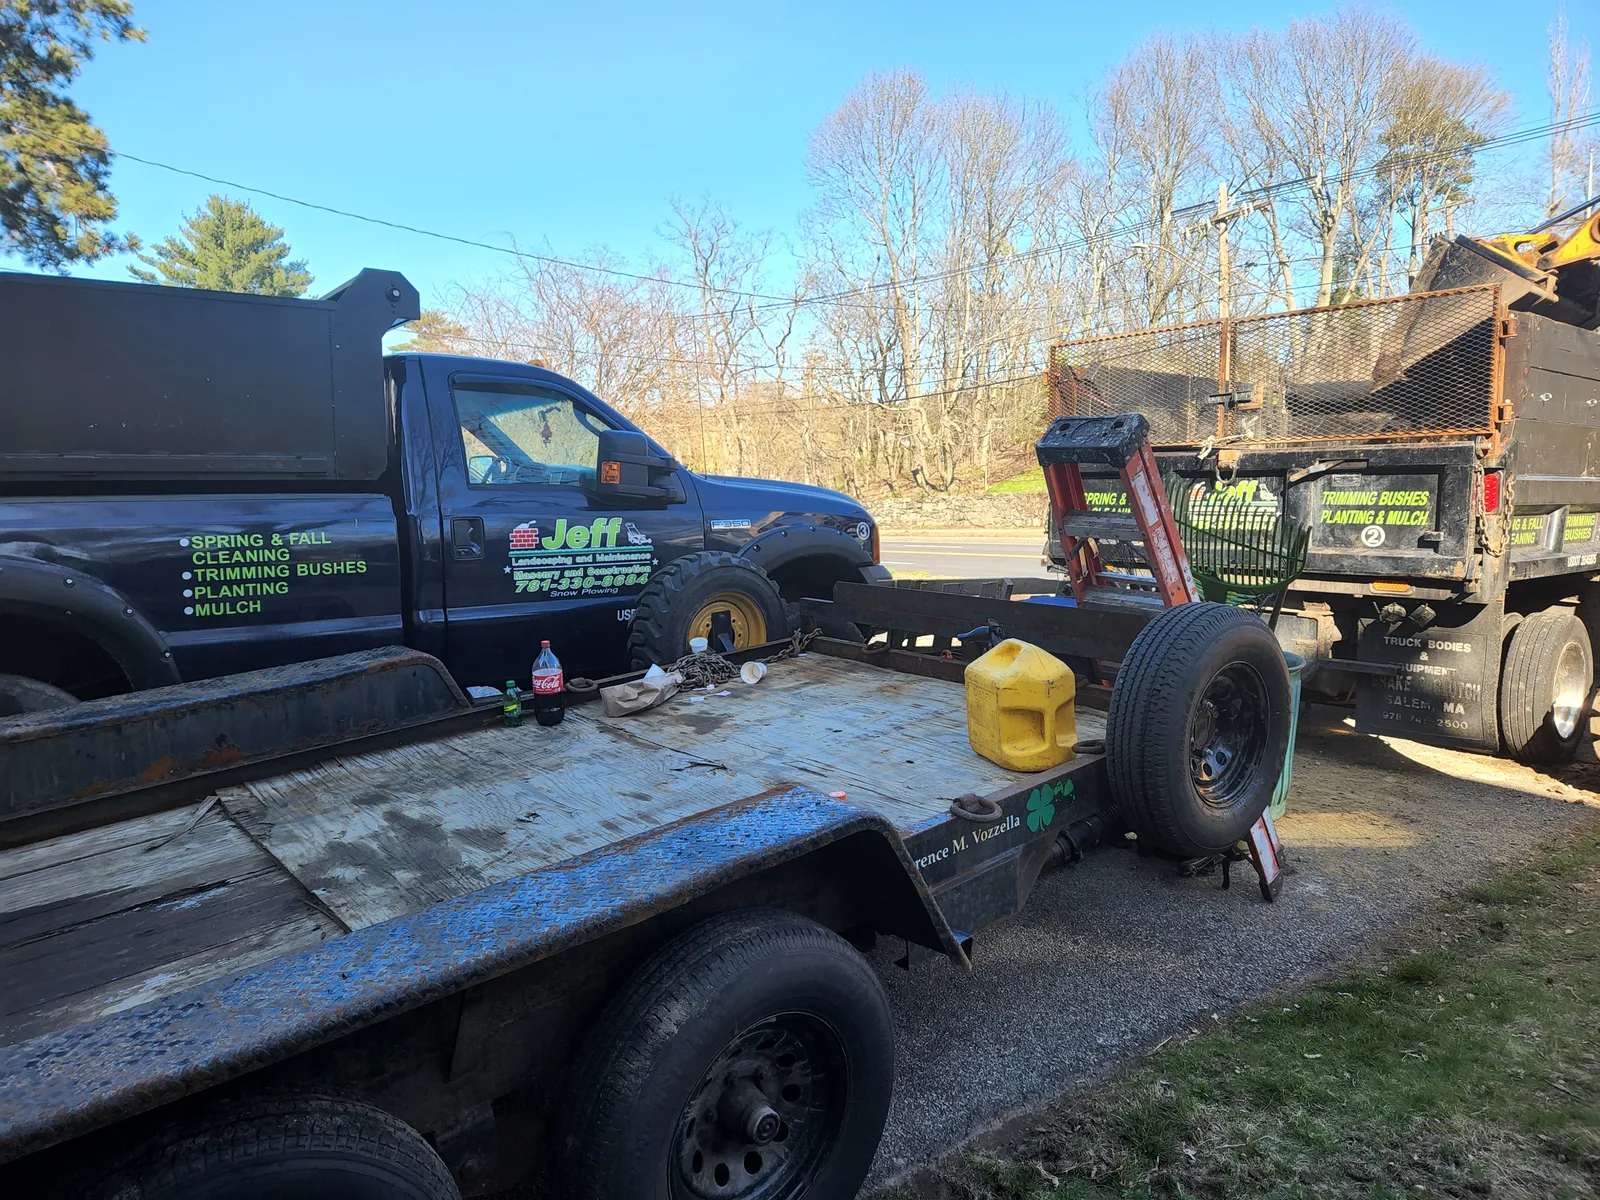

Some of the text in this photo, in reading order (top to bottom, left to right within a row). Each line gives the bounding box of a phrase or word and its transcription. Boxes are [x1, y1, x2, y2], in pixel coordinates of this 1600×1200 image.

[1119, 492, 1127, 505] &
[1322, 491, 1429, 506] TRIMMING BUSHES
[1320, 509, 1429, 526] PLANTING & MULCH
[1522, 518, 1528, 530] &
[1528, 517, 1544, 530] FALL
[1566, 515, 1596, 527] RIMMING
[191, 531, 332, 549] SPRING & FALL
[541, 517, 622, 550] Jeff
[1367, 528, 1379, 544] 2
[1564, 527, 1592, 541] BUSHES
[192, 548, 290, 565] CLEANING
[512, 552, 651, 567] Landscaping and Maintenance
[193, 560, 367, 582] TRIMMING BUSHES
[513, 564, 652, 581] Masonry and Construction
[194, 581, 289, 600] PLANTING
[515, 573, 649, 594] 781-330-8684
[549, 586, 619, 598] Snow Plowing
[195, 600, 262, 617] MULCH
[1383, 636, 1472, 653] TRUCK BODIES
[1420, 651, 1429, 661] &
[1390, 662, 1457, 676] UIPMENT
[1443, 702, 1465, 715] MA
[1382, 711, 1402, 721] 978
[1437, 718, 1469, 730] 2500
[952, 836, 969, 854] M.
[972, 815, 1021, 844] Vozzella
